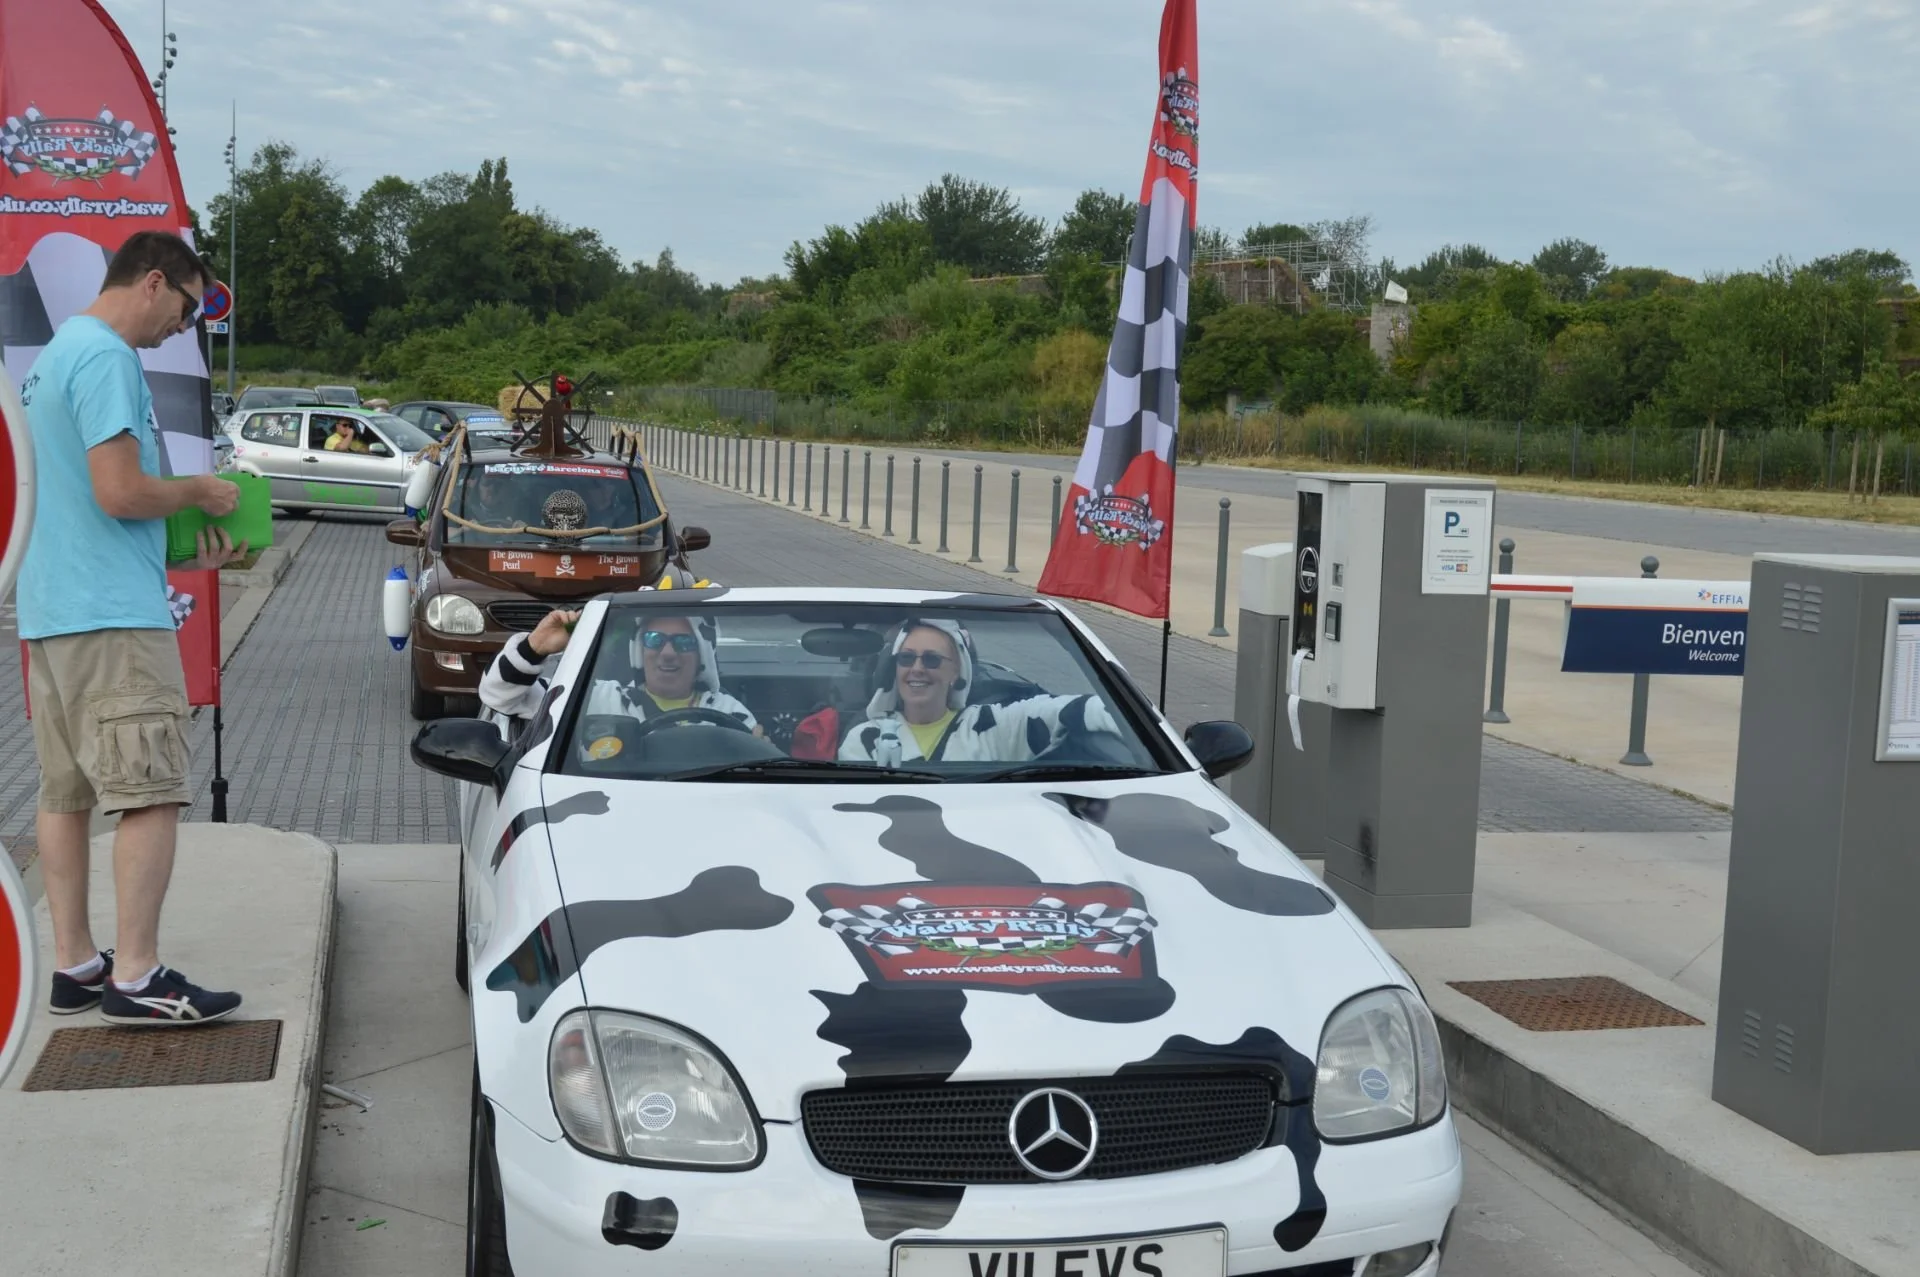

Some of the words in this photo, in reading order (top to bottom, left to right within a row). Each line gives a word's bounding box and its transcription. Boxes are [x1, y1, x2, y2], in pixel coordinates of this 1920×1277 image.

[547, 465, 601, 475] Barcelona
[508, 551, 533, 560] Brown
[598, 555, 613, 564] The
[616, 555, 639, 565] Brown
[502, 560, 521, 570] Pearl
[609, 565, 628, 575] Pearl
[1712, 594, 1744, 605] EFFIA
[1688, 649, 1740, 662] Welcome
[881, 919, 996, 939] Wacky
[1007, 919, 1101, 939] Rally
[903, 963, 1122, 976] www.wackyrally.co.uk
